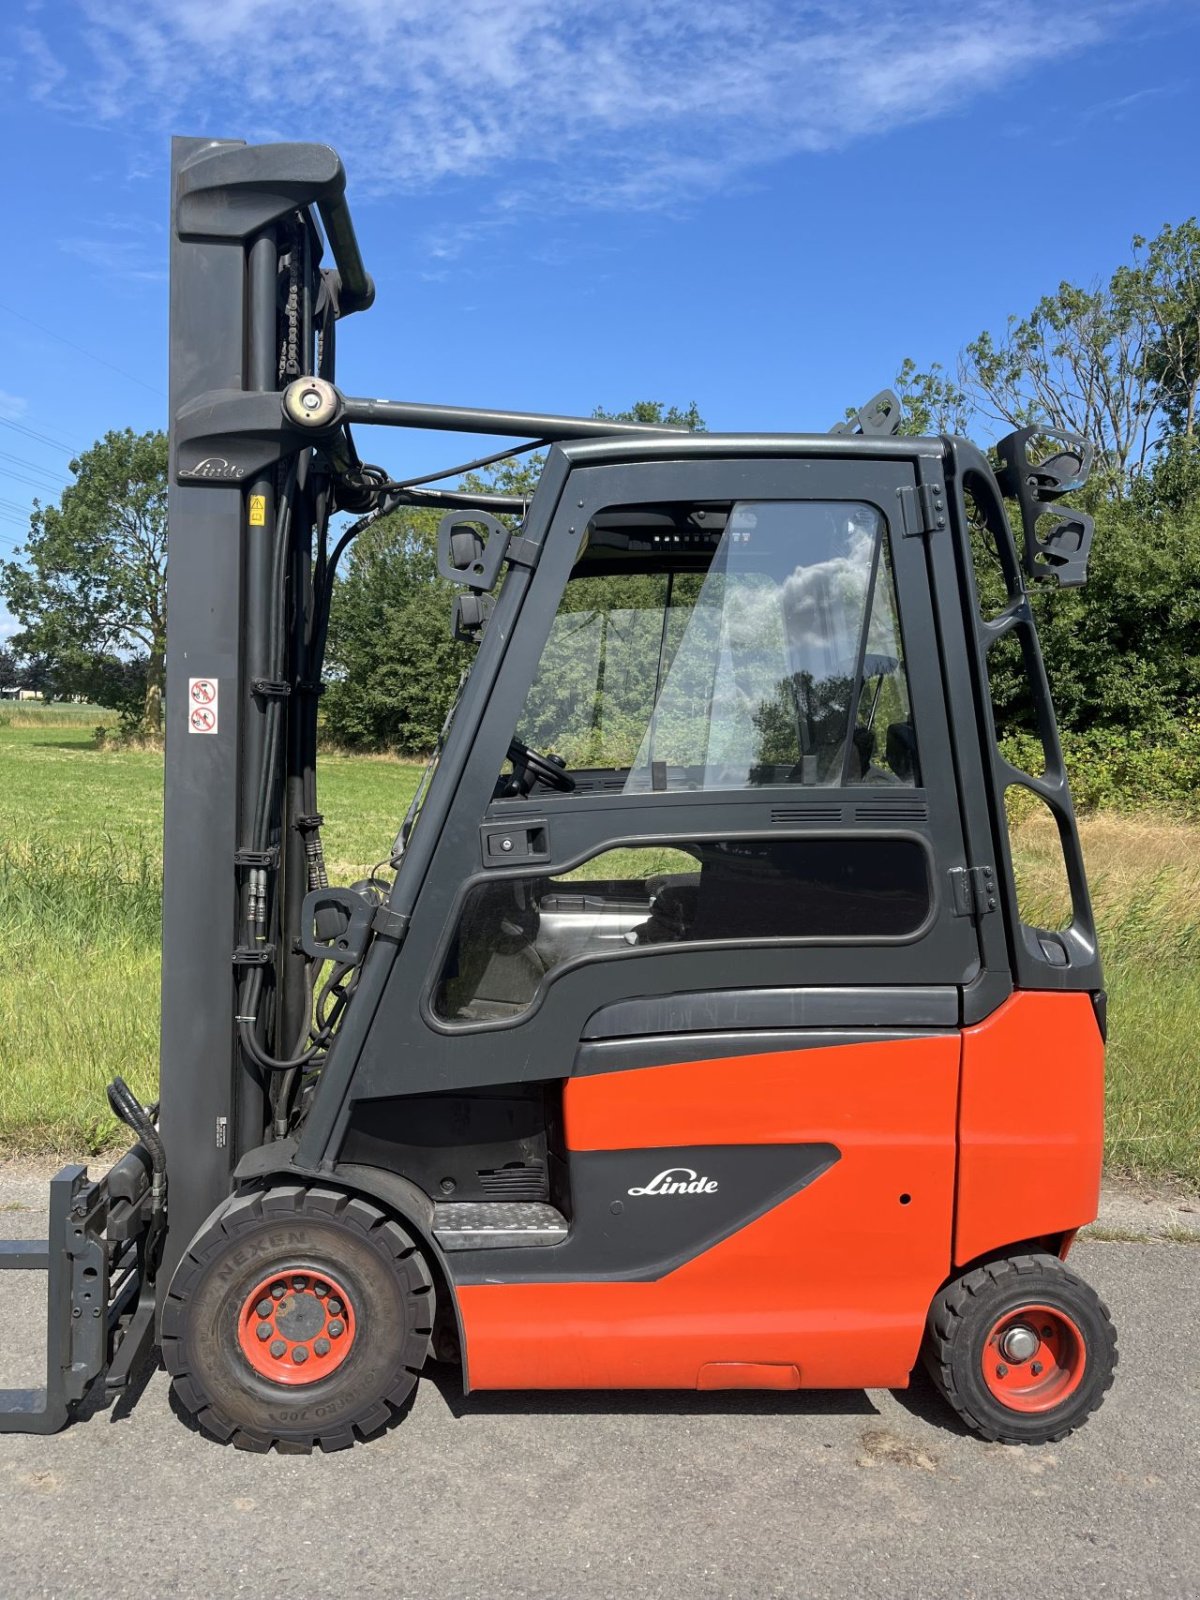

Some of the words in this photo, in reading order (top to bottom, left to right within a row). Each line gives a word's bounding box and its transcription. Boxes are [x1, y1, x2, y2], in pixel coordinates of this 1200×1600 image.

[179, 457, 244, 478] Linde
[627, 1167, 719, 1196] Linde
[218, 1231, 306, 1282] NEXEN
